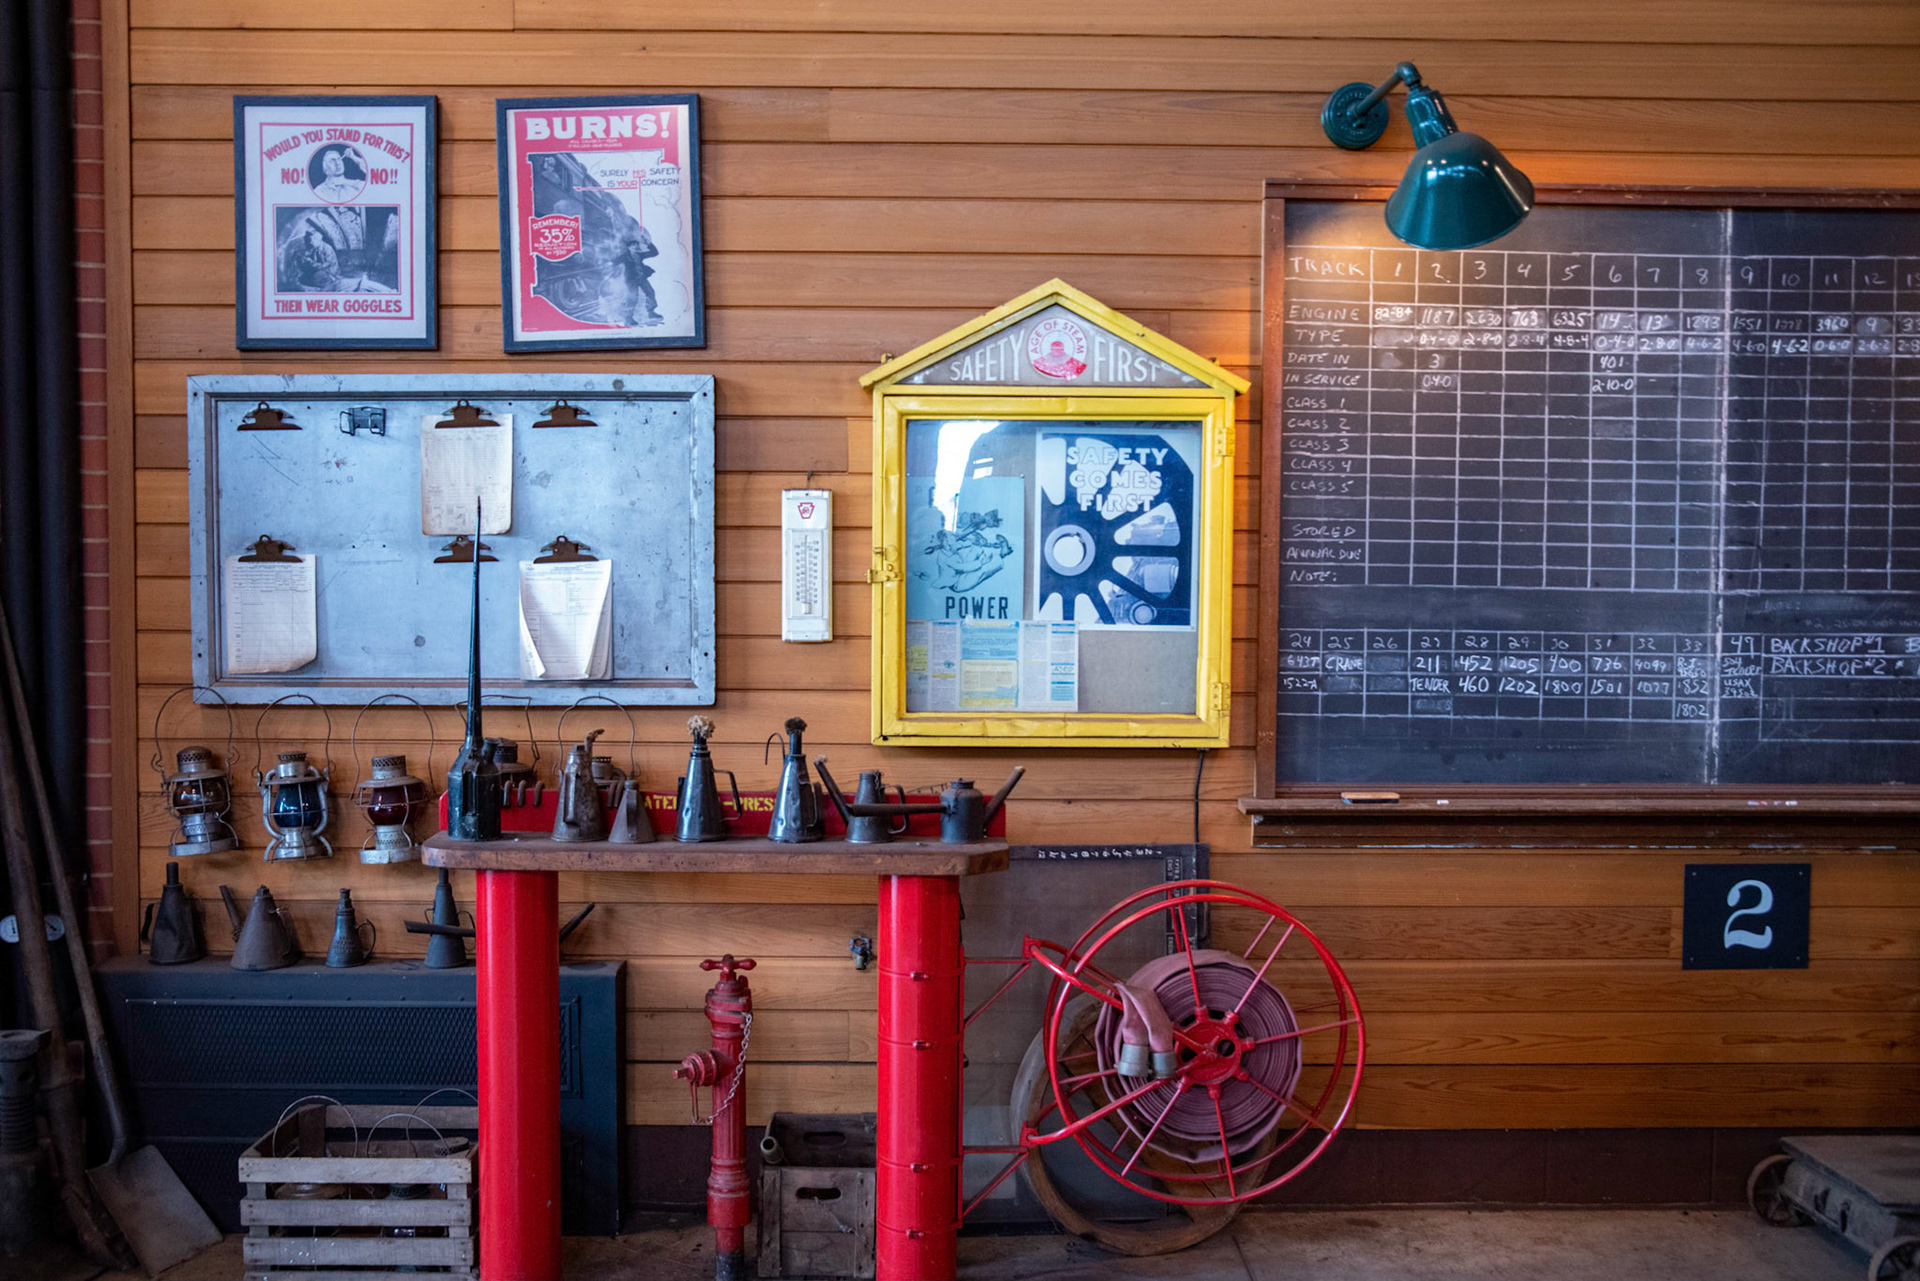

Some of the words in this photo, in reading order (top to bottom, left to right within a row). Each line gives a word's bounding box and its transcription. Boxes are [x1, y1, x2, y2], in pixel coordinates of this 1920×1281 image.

[525, 111, 671, 141] BURNS!
[263, 136, 301, 162] WOULD
[301, 129, 324, 145] YOU
[326, 128, 361, 143] STAND
[362, 132, 384, 151] FOR
[384, 139, 411, 163] THIS?
[281, 168, 305, 184] NO!
[370, 168, 398, 184] NO!!
[600, 169, 629, 178] SURELY
[649, 167, 681, 176] SAFETY
[607, 179, 616, 188] IS
[616, 179, 638, 187] YOUR
[641, 178, 679, 187] CONCERN
[532, 218, 579, 230] REMEMBER!
[540, 228, 576, 244] 35%
[1290, 257, 1364, 276] TRACK
[1395, 263, 1402, 277] 1
[1431, 263, 1450, 283] 2
[1474, 261, 1487, 280] 3
[1517, 263, 1532, 278] 4
[1561, 264, 1580, 281] 5
[1608, 265, 1622, 283] 6
[1646, 267, 1660, 283] 7
[1696, 268, 1709, 285] 8
[1740, 265, 1754, 285] 9
[1781, 273, 1800, 286] 10
[1825, 273, 1838, 286] 11
[1864, 273, 1886, 286] 12
[274, 299, 302, 313] THEN
[306, 299, 339, 313] WEAR
[343, 299, 403, 313] GOGGLES
[1289, 305, 1361, 322] ENGINE
[1421, 308, 1455, 325] 1187
[1466, 310, 1502, 326] 2630
[1511, 310, 1539, 326] 763
[1553, 310, 1592, 327] 6325
[1686, 314, 1721, 329] 1293
[1733, 316, 1762, 331] 1551
[1816, 318, 1849, 332] 3960
[1866, 317, 1877, 332] 9
[1030, 329, 1042, 355] AGE
[1043, 320, 1058, 331] OF
[1062, 322, 1085, 354] STEAM
[1294, 329, 1345, 343] TYPE
[950, 328, 1025, 382] SAFETY
[1093, 335, 1161, 382] FIRST
[1288, 352, 1328, 363] DATE
[1333, 354, 1350, 364] IN
[1429, 353, 1441, 369] 3
[1285, 374, 1299, 383] IN
[1304, 374, 1361, 386] SERVICE
[1286, 397, 1327, 408] CLASS
[1340, 398, 1345, 408] 1
[1287, 418, 1329, 430] CLASS
[1339, 418, 1350, 430] 2
[1289, 439, 1330, 451] CLASS
[1336, 438, 1349, 452] 3
[1066, 446, 1169, 466] SAFETY
[1291, 458, 1335, 471] CLASS
[1341, 459, 1352, 472] 4
[1069, 469, 1163, 489] COMES
[1291, 481, 1335, 492] CLASS
[1341, 481, 1354, 493] 5
[1080, 493, 1155, 512] FIRST
[1292, 524, 1356, 538] STORED
[1286, 547, 1336, 559] ANNUAL
[1338, 548, 1361, 560] DUE
[945, 596, 1008, 619] POWER
[1289, 632, 1312, 649] 24
[1327, 636, 1354, 650] 25
[1373, 636, 1398, 649] 26
[1464, 635, 1489, 648] 28
[1508, 637, 1529, 649] 29
[1594, 638, 1612, 650] 31
[1637, 638, 1657, 651] 32
[1682, 638, 1703, 652] 33
[1325, 656, 1364, 671] CRANE
[1460, 655, 1492, 672] 452
[1592, 656, 1622, 672] 736
[1411, 678, 1450, 693] TENDER
[1458, 675, 1489, 692] 460
[1499, 677, 1539, 695] 1202
[1545, 679, 1582, 694] 1800
[1590, 679, 1622, 695] 1501
[1676, 703, 1710, 718] 1802
[1724, 879, 1773, 950] 2
